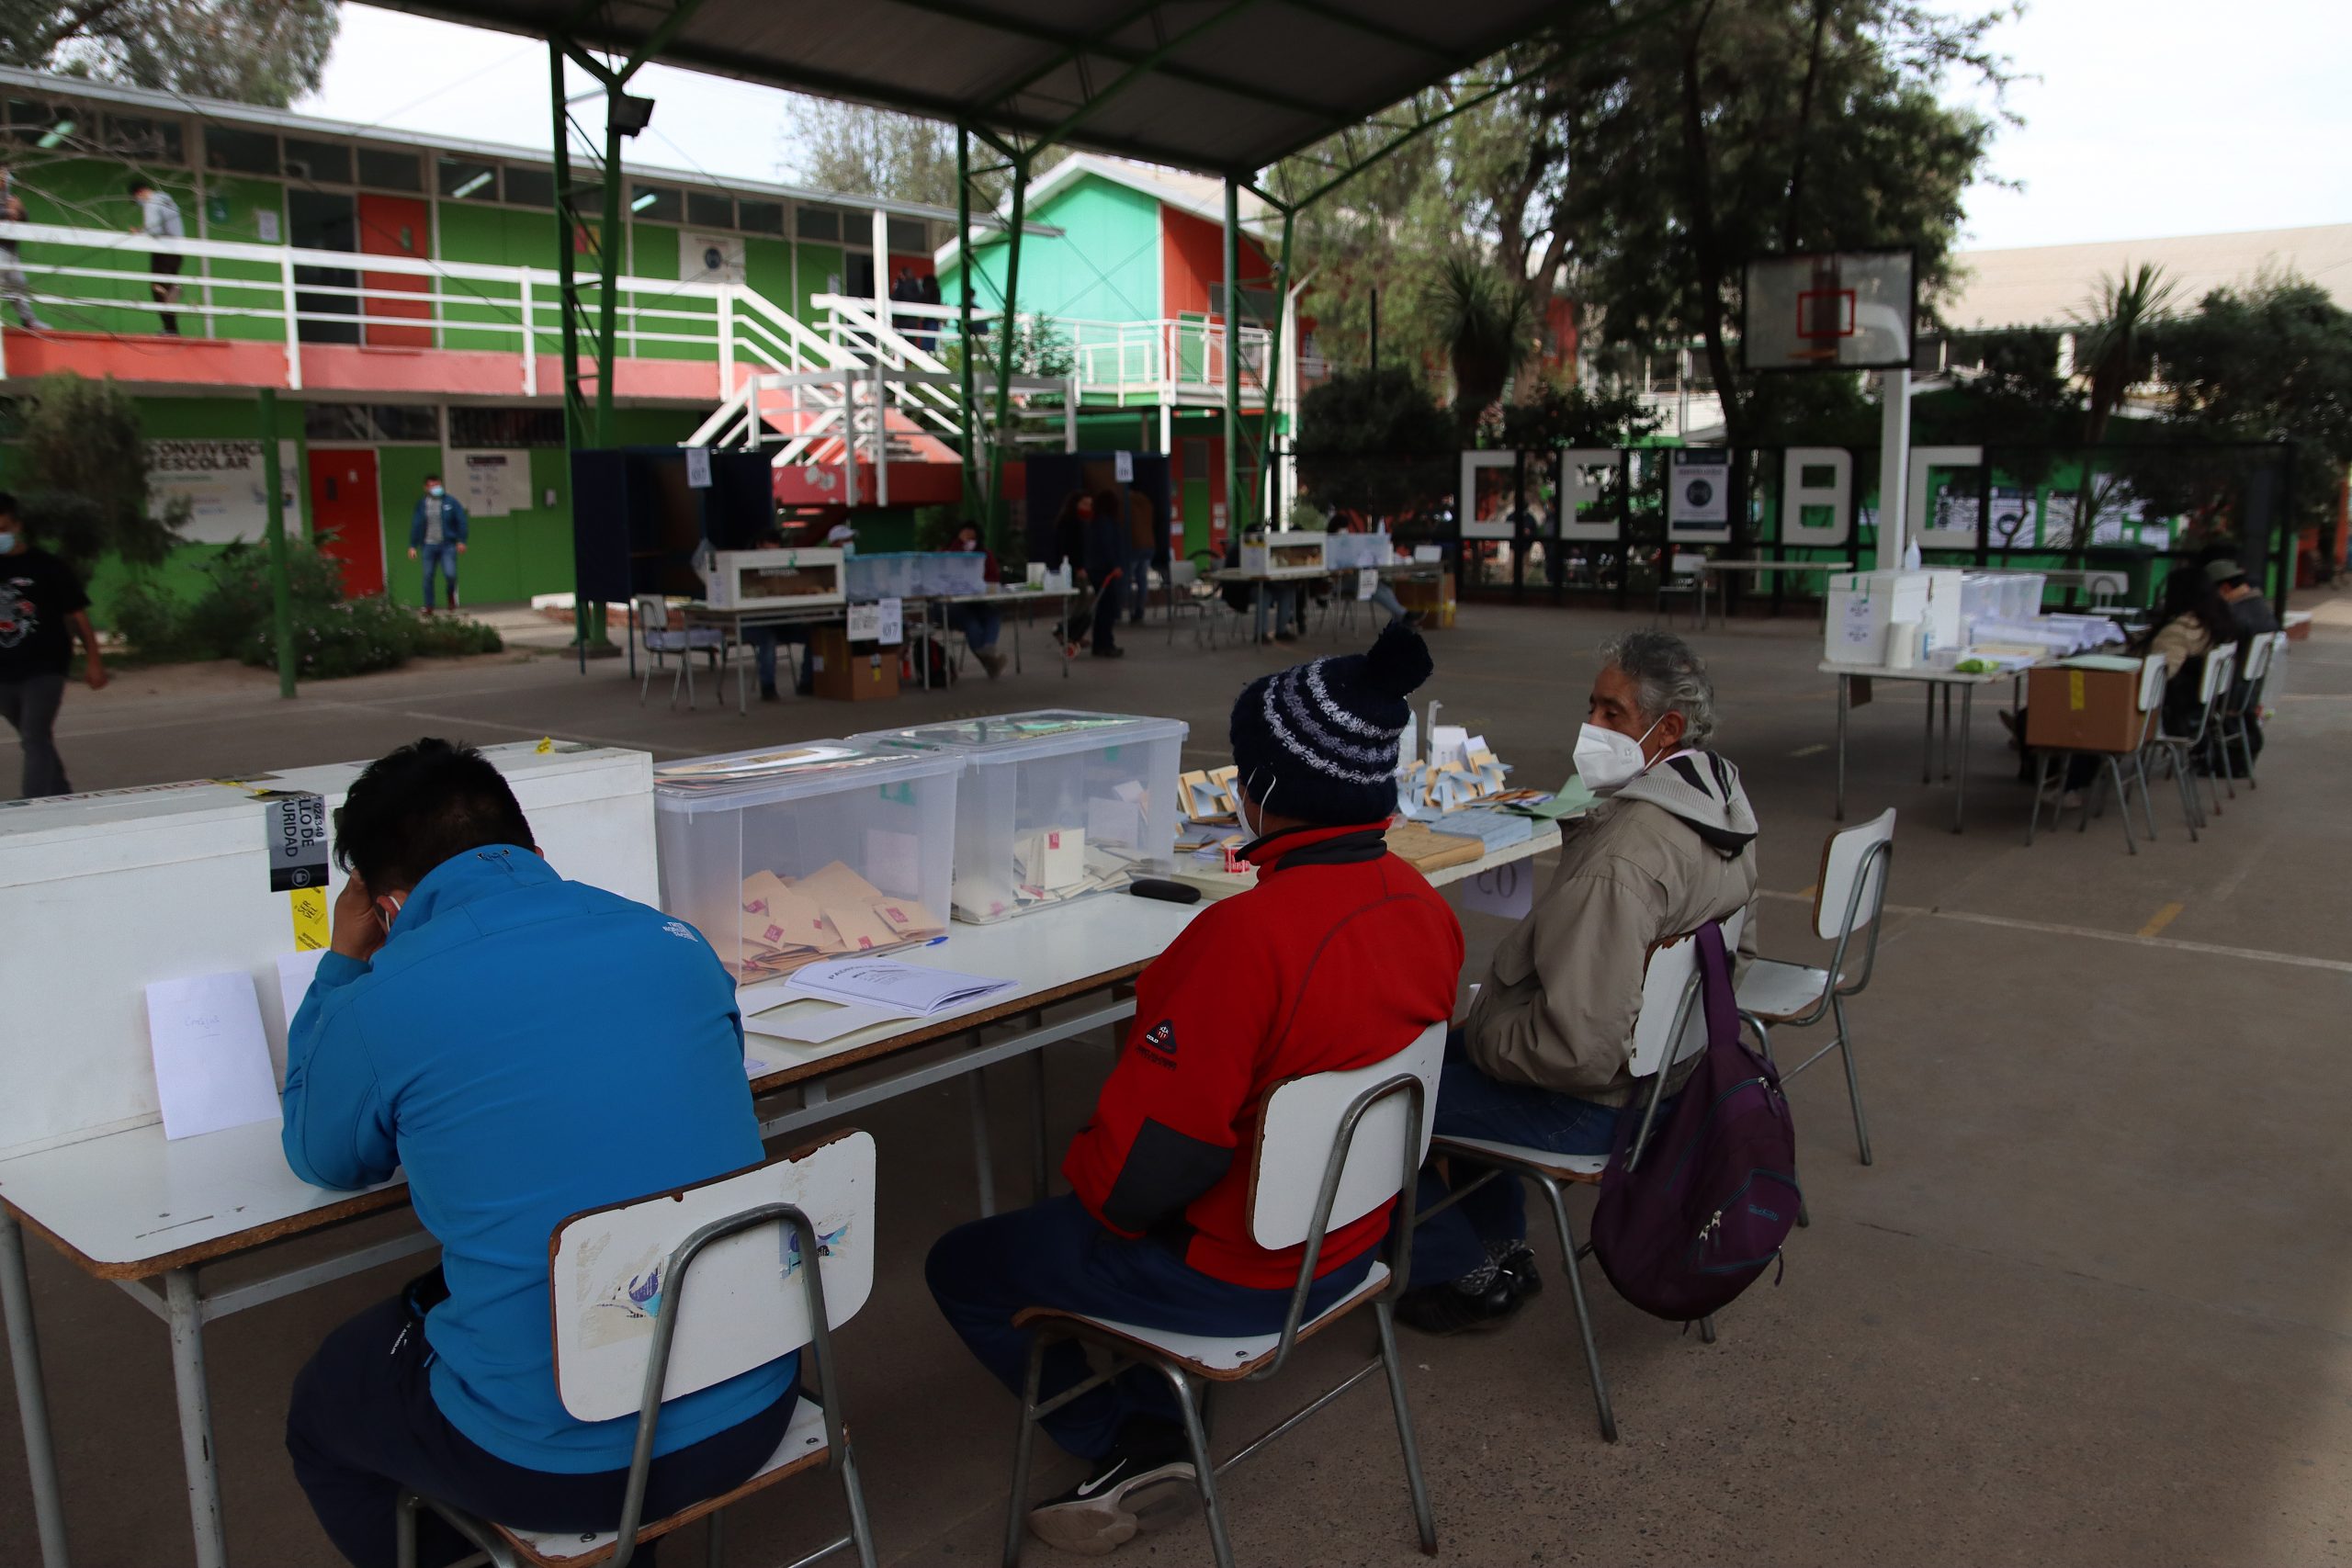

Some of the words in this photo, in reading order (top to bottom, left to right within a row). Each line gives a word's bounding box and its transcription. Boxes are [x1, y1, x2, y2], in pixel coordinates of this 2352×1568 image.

[299, 796, 312, 825] LLO
[313, 802, 323, 838] 024340
[281, 799, 299, 857] URIDAD
[300, 827, 314, 847] DE
